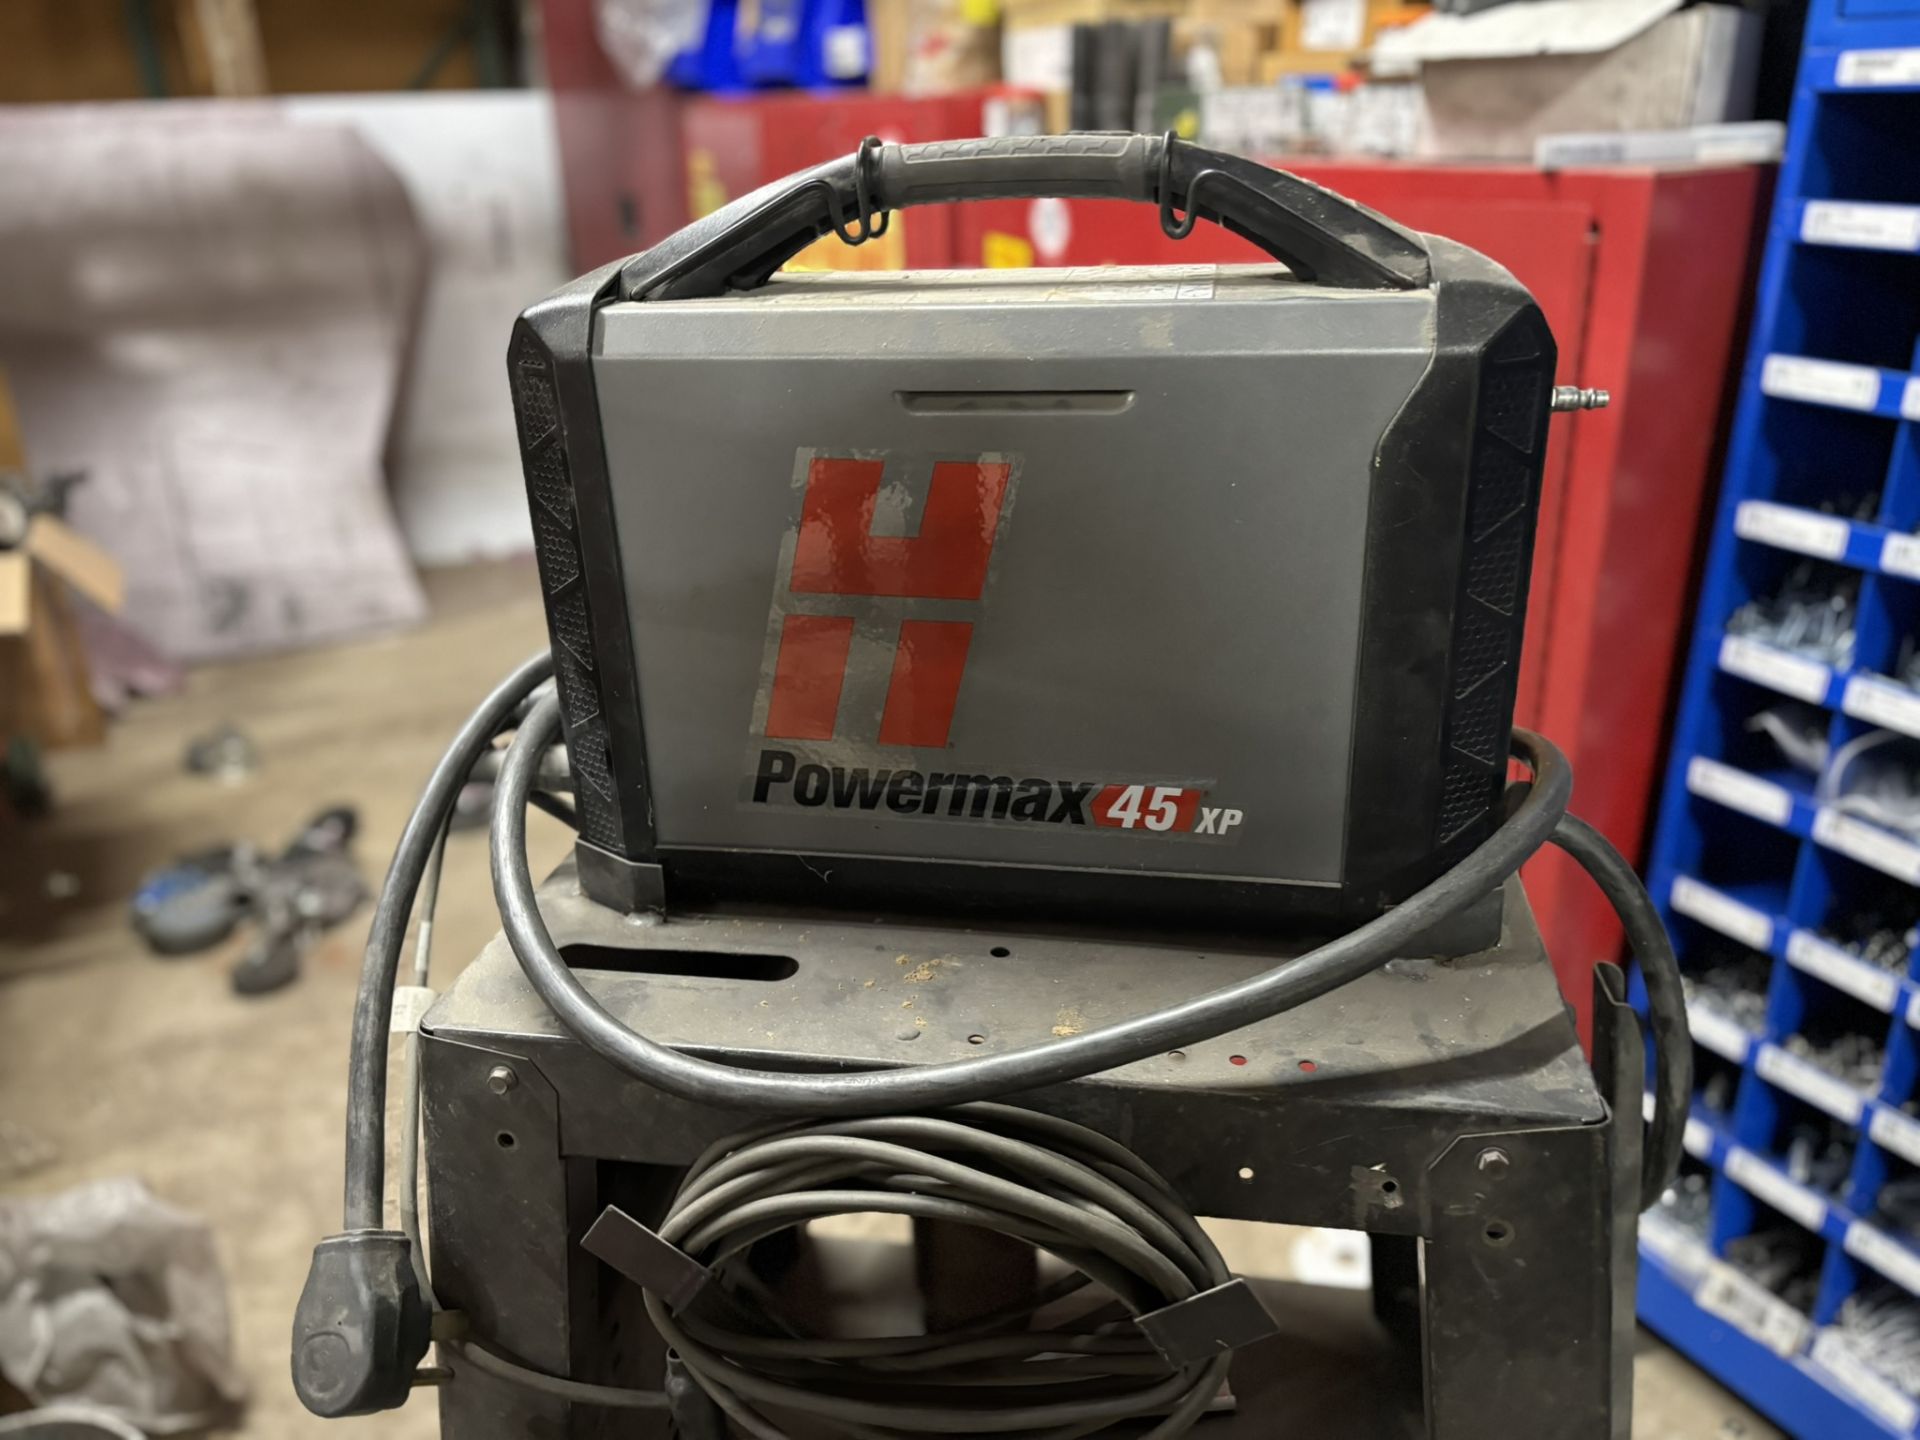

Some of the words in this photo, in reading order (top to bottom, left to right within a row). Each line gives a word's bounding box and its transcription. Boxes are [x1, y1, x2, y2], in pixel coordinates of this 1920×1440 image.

[753, 750, 1094, 825] Powermax
[1107, 785, 1182, 831] 45
[1194, 807, 1243, 835] XP
